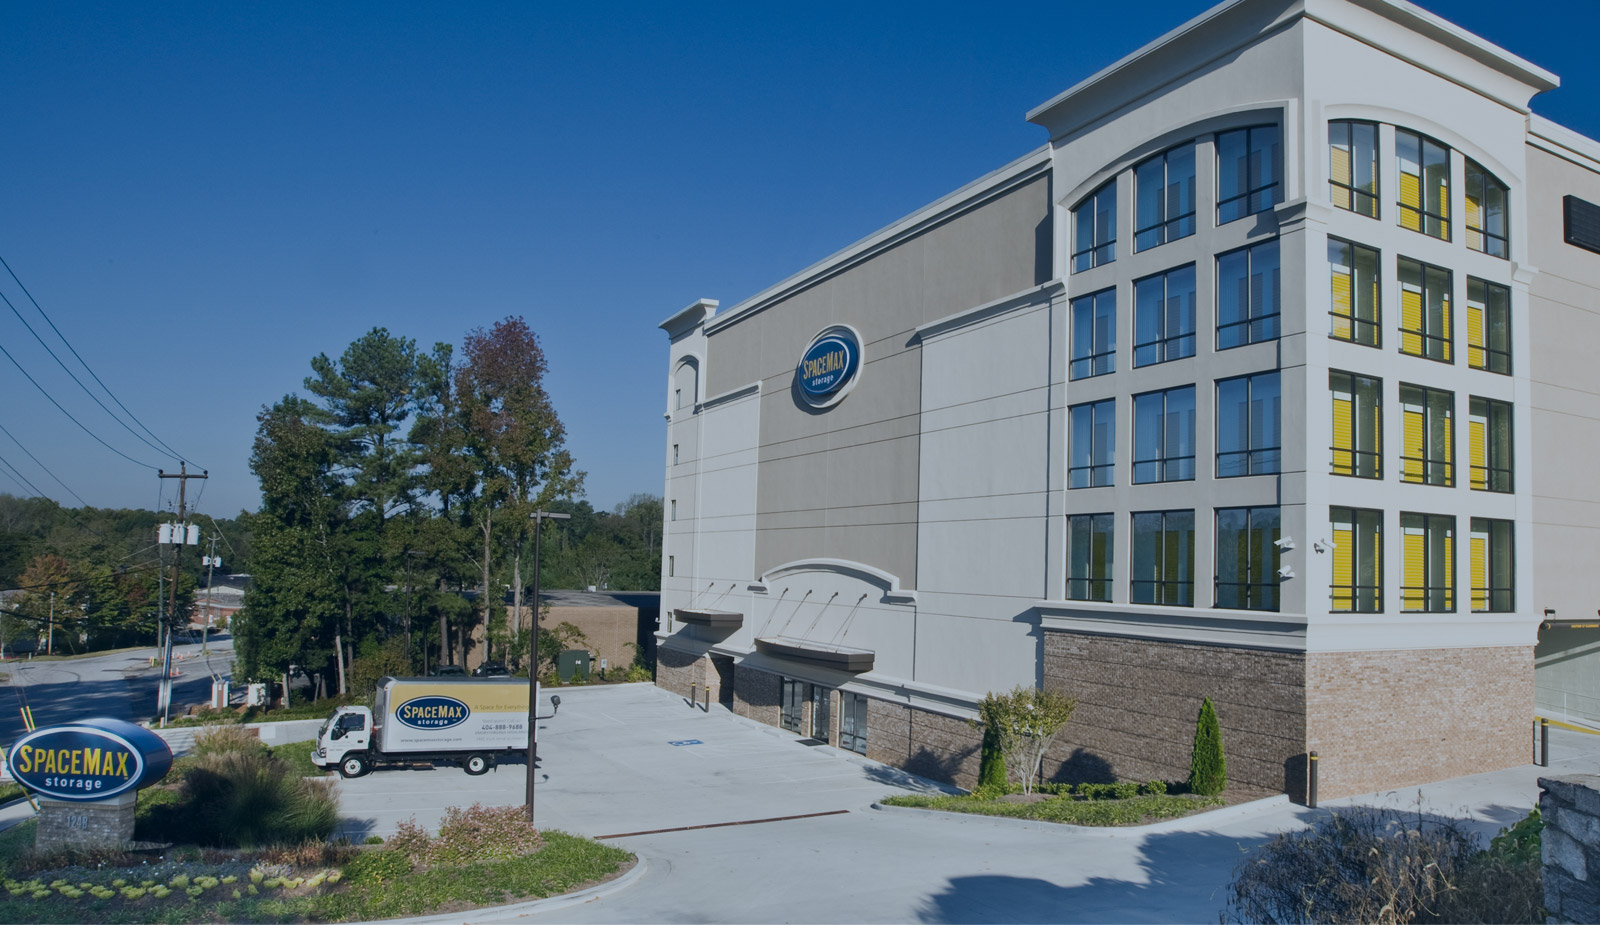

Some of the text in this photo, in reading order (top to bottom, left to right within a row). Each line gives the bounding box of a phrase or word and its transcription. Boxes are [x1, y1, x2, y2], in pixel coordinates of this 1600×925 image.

[803, 350, 844, 380] SPACEMAX
[812, 375, 834, 387] storage
[403, 705, 463, 719] SPACEMAX
[19, 745, 129, 777] SPACEMAX
[45, 777, 102, 791] storage
[66, 815, 88, 829] 1248
